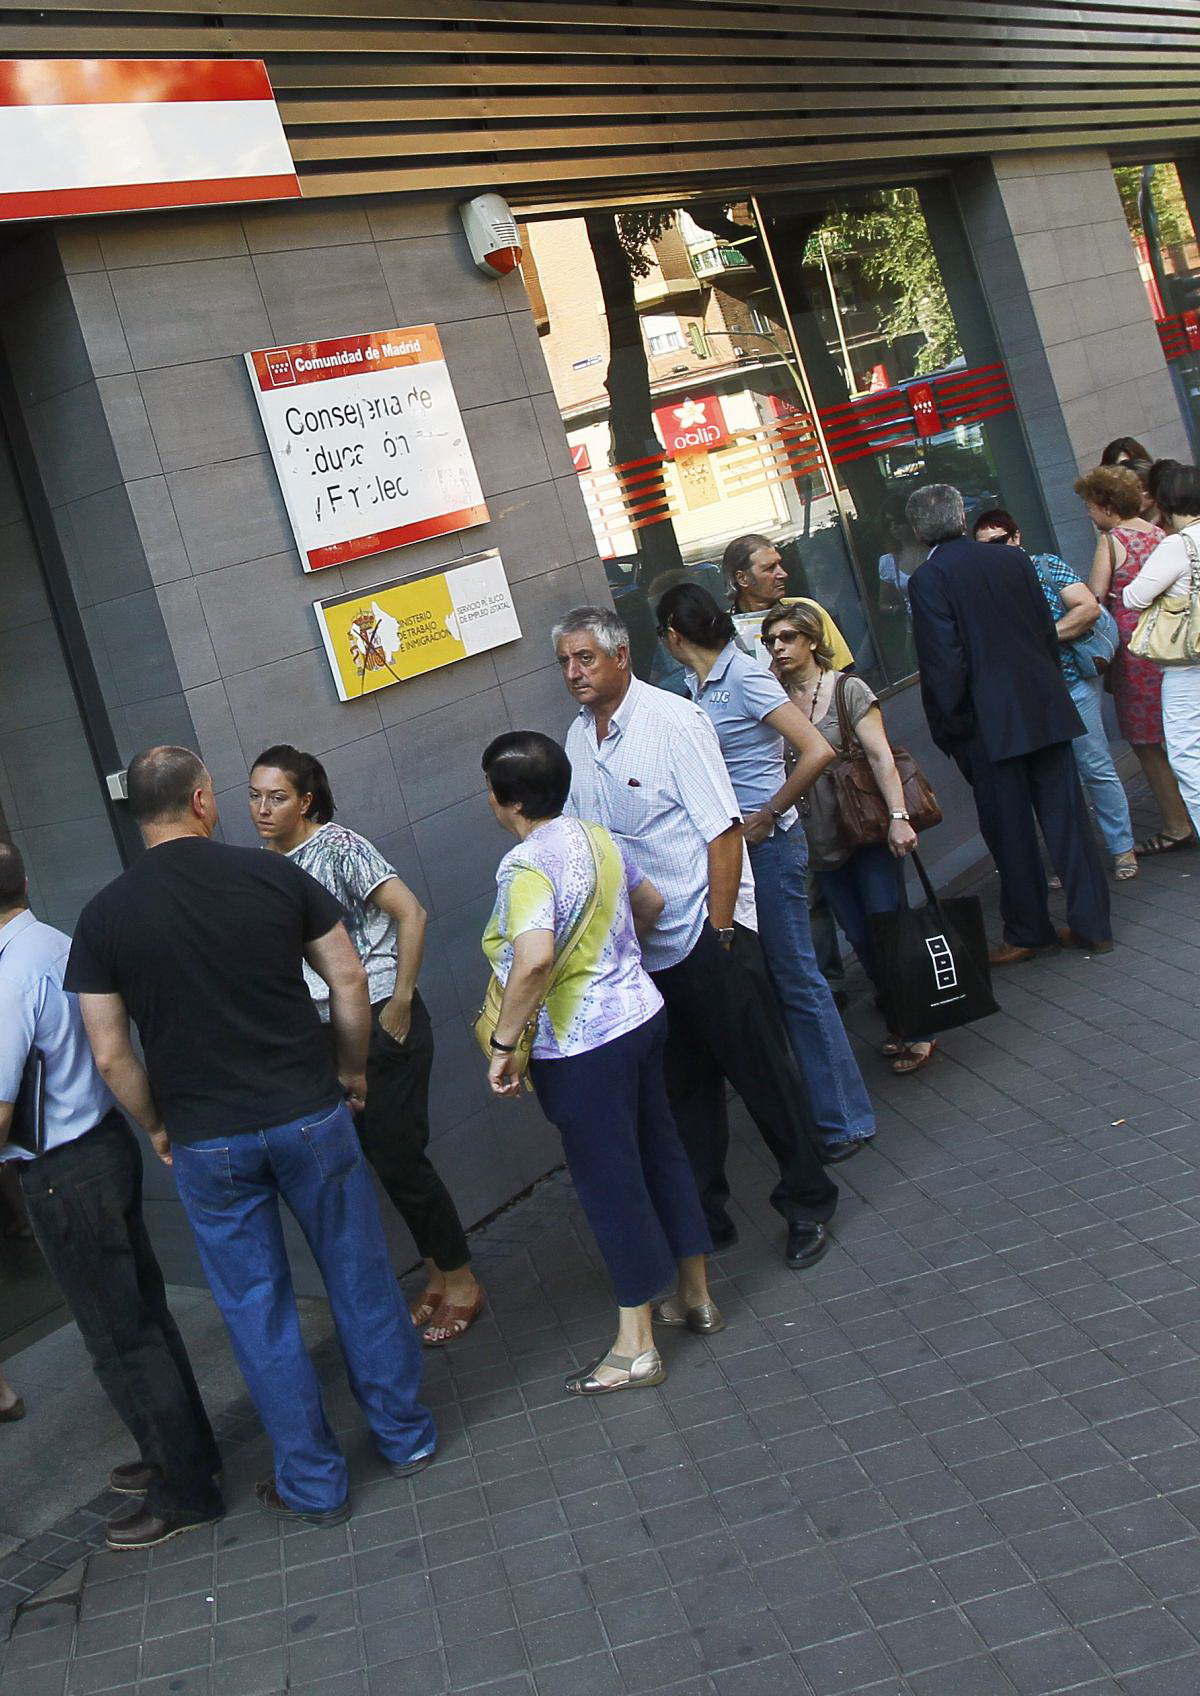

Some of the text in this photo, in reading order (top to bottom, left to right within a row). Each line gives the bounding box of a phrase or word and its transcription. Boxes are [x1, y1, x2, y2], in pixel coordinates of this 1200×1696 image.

[295, 339, 421, 372] Comunidad de Madrid
[407, 621, 437, 639] TRABAJO
